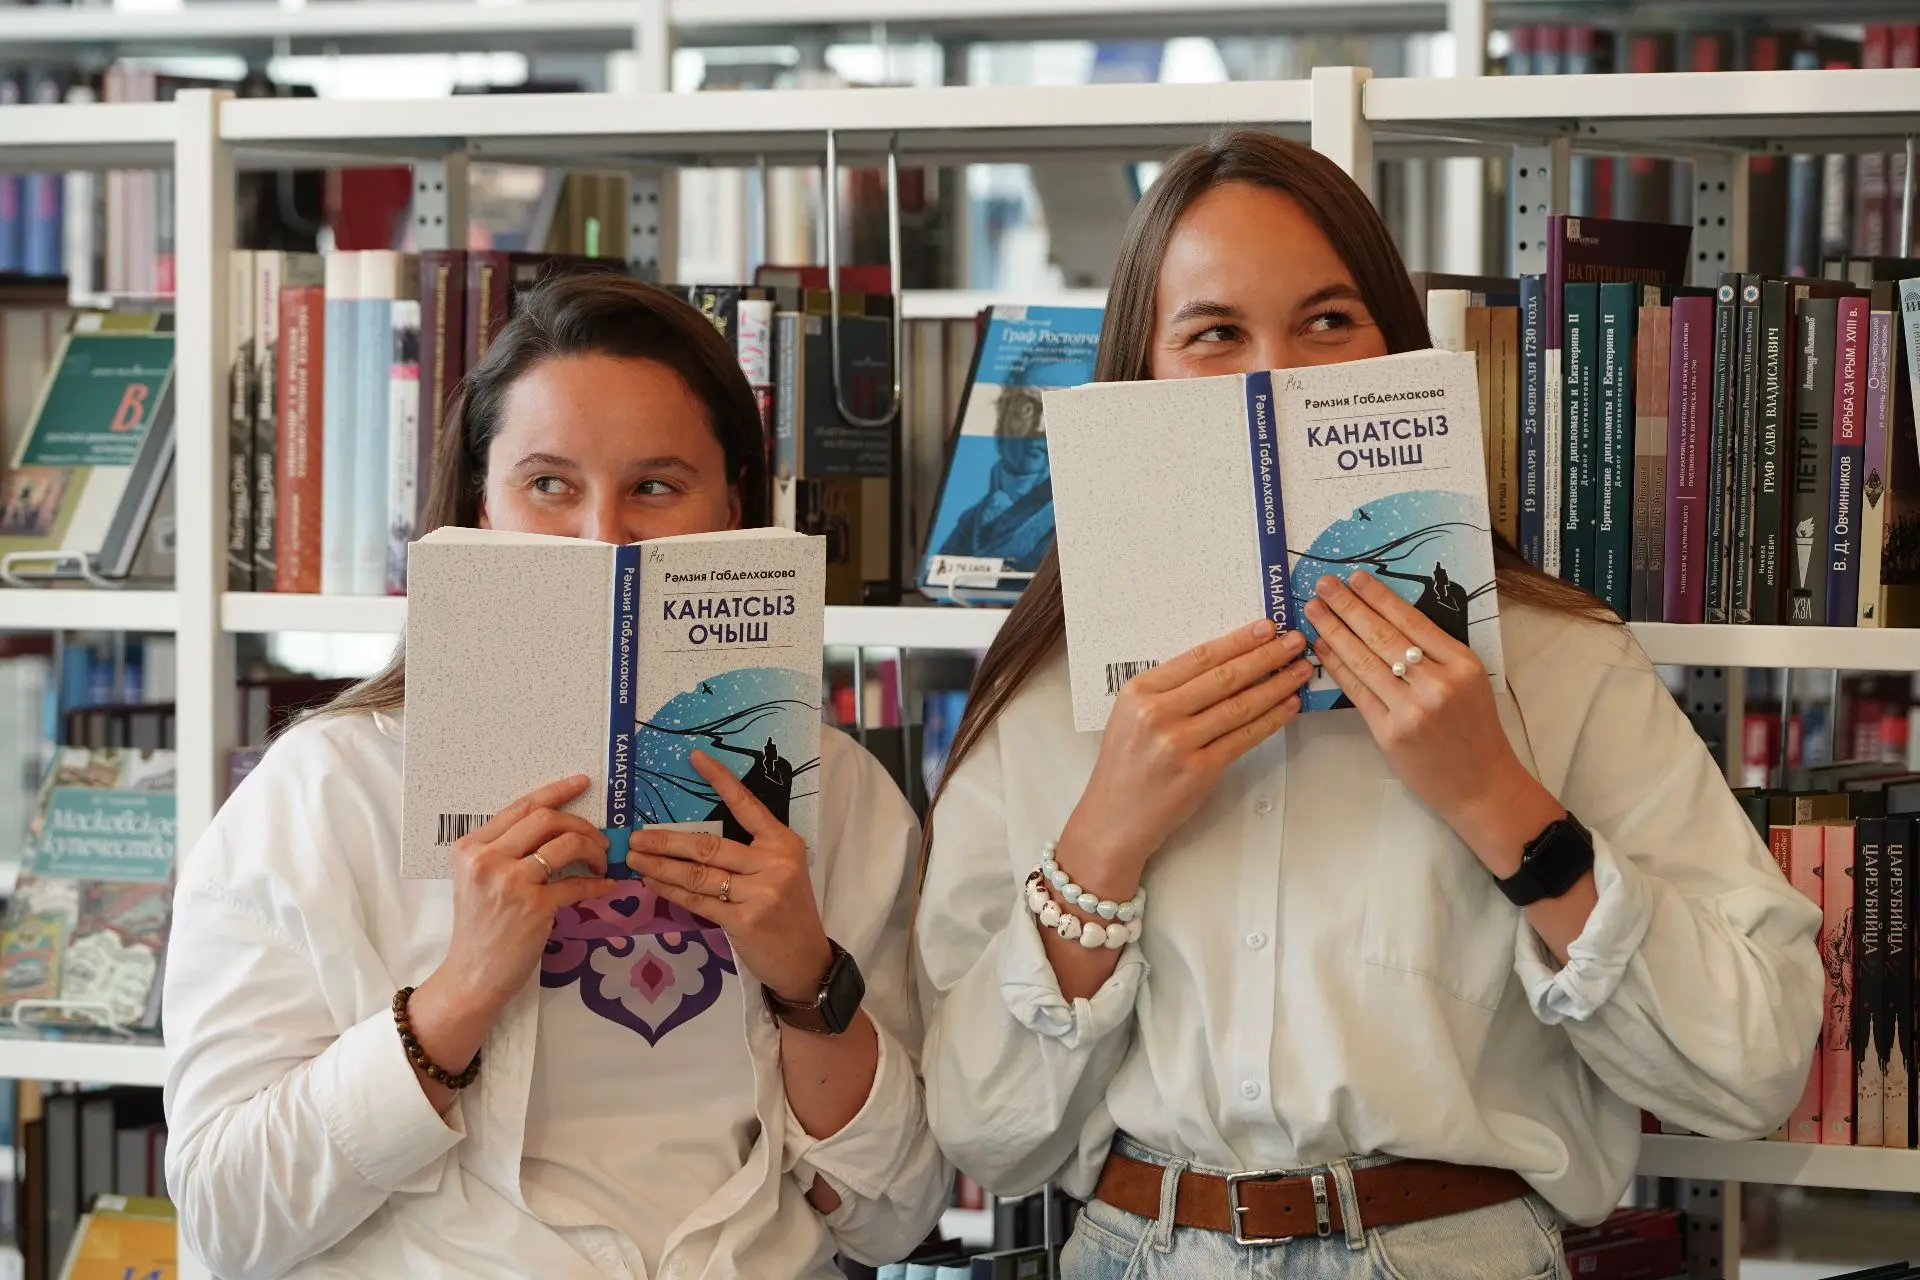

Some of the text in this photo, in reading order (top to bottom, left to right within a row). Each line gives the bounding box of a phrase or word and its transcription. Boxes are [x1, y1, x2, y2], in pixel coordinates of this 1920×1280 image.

[1002, 327, 1037, 344] Граф
[1846, 320, 1858, 343] XVIII
[1868, 317, 1881, 389] Очень хороший
[1568, 327, 1581, 385] Екатерина
[1603, 328, 1615, 385] Екатерина
[1845, 345, 1857, 379] КРЫМ.
[1878, 361, 1888, 393] дурной
[1305, 388, 1445, 409] Рәмзия Габделхакова
[1524, 295, 1538, 513] 19 ЯНВАРЯ 25 ФЕВРАЛЯ 1730 ГОДА
[1763, 327, 1779, 493] ГРАФ САВА ВЛАДИСЛАВИЧ
[1844, 381, 1855, 395] ЗА
[1307, 414, 1449, 448] КАНАТСЫЗ
[1569, 401, 1580, 462] дипломаты
[1603, 401, 1613, 463] дипломаты
[1689, 433, 1696, 443] ИХ
[1842, 397, 1854, 438] БОРЬБА
[1337, 443, 1423, 471] ОЧЫШ
[1679, 438, 1687, 487] ИМПЕРАТРИЦА
[1797, 412, 1818, 493] ПЕТР III
[1255, 394, 1288, 640] Рәмзия Габделхакова КАНАТСЫ
[1567, 466, 1579, 530] Британские
[1601, 467, 1613, 531] Британские
[1833, 456, 1852, 571] В. Д. Овчинников
[1681, 505, 1689, 553] ГАРНОВСКОГО
[664, 569, 796, 583] Рәмзия Габделхакова
[1606, 549, 1614, 590] Лабутина
[1710, 541, 1720, 587] Митрофанов
[1736, 541, 1745, 587] Митрофанов
[1758, 545, 1766, 574] Никола
[1767, 534, 1775, 586] МОРАВЧЕВИЧ
[620, 567, 635, 612] Рәмзия
[663, 594, 796, 621] КАНАТСЫЗ
[1792, 597, 1812, 619] ЖЗЛ
[688, 622, 768, 645] ОЧЫШ
[618, 614, 633, 704] Габделхакова
[613, 734, 630, 810] КАНАТСЫЗ
[54, 807, 176, 837] Московско
[1862, 844, 1883, 955] ЦАРЕУБИЙЦА
[1887, 844, 1908, 955] ЦАРЕУБИЙЦА
